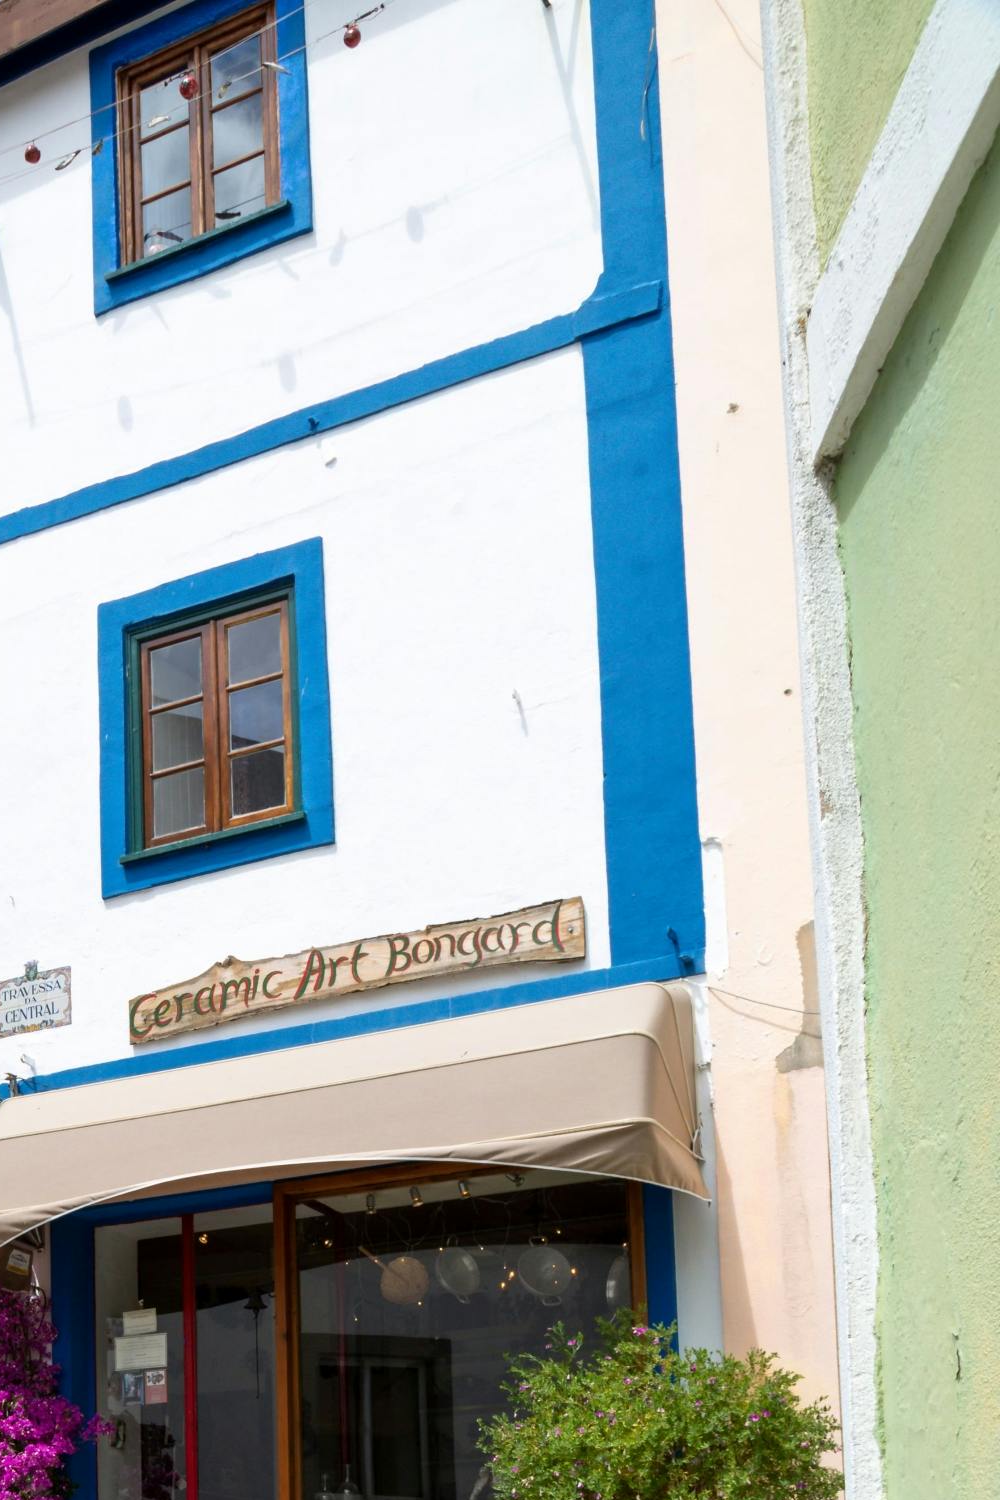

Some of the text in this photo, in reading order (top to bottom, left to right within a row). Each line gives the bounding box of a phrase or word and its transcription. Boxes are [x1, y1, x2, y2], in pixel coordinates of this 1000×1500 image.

[130, 901, 566, 1039] Ceramic Art Bongard
[2, 979, 62, 1002] TRAVESSA
[24, 996, 37, 1005] DA
[5, 1001, 60, 1024] CENTRAL
